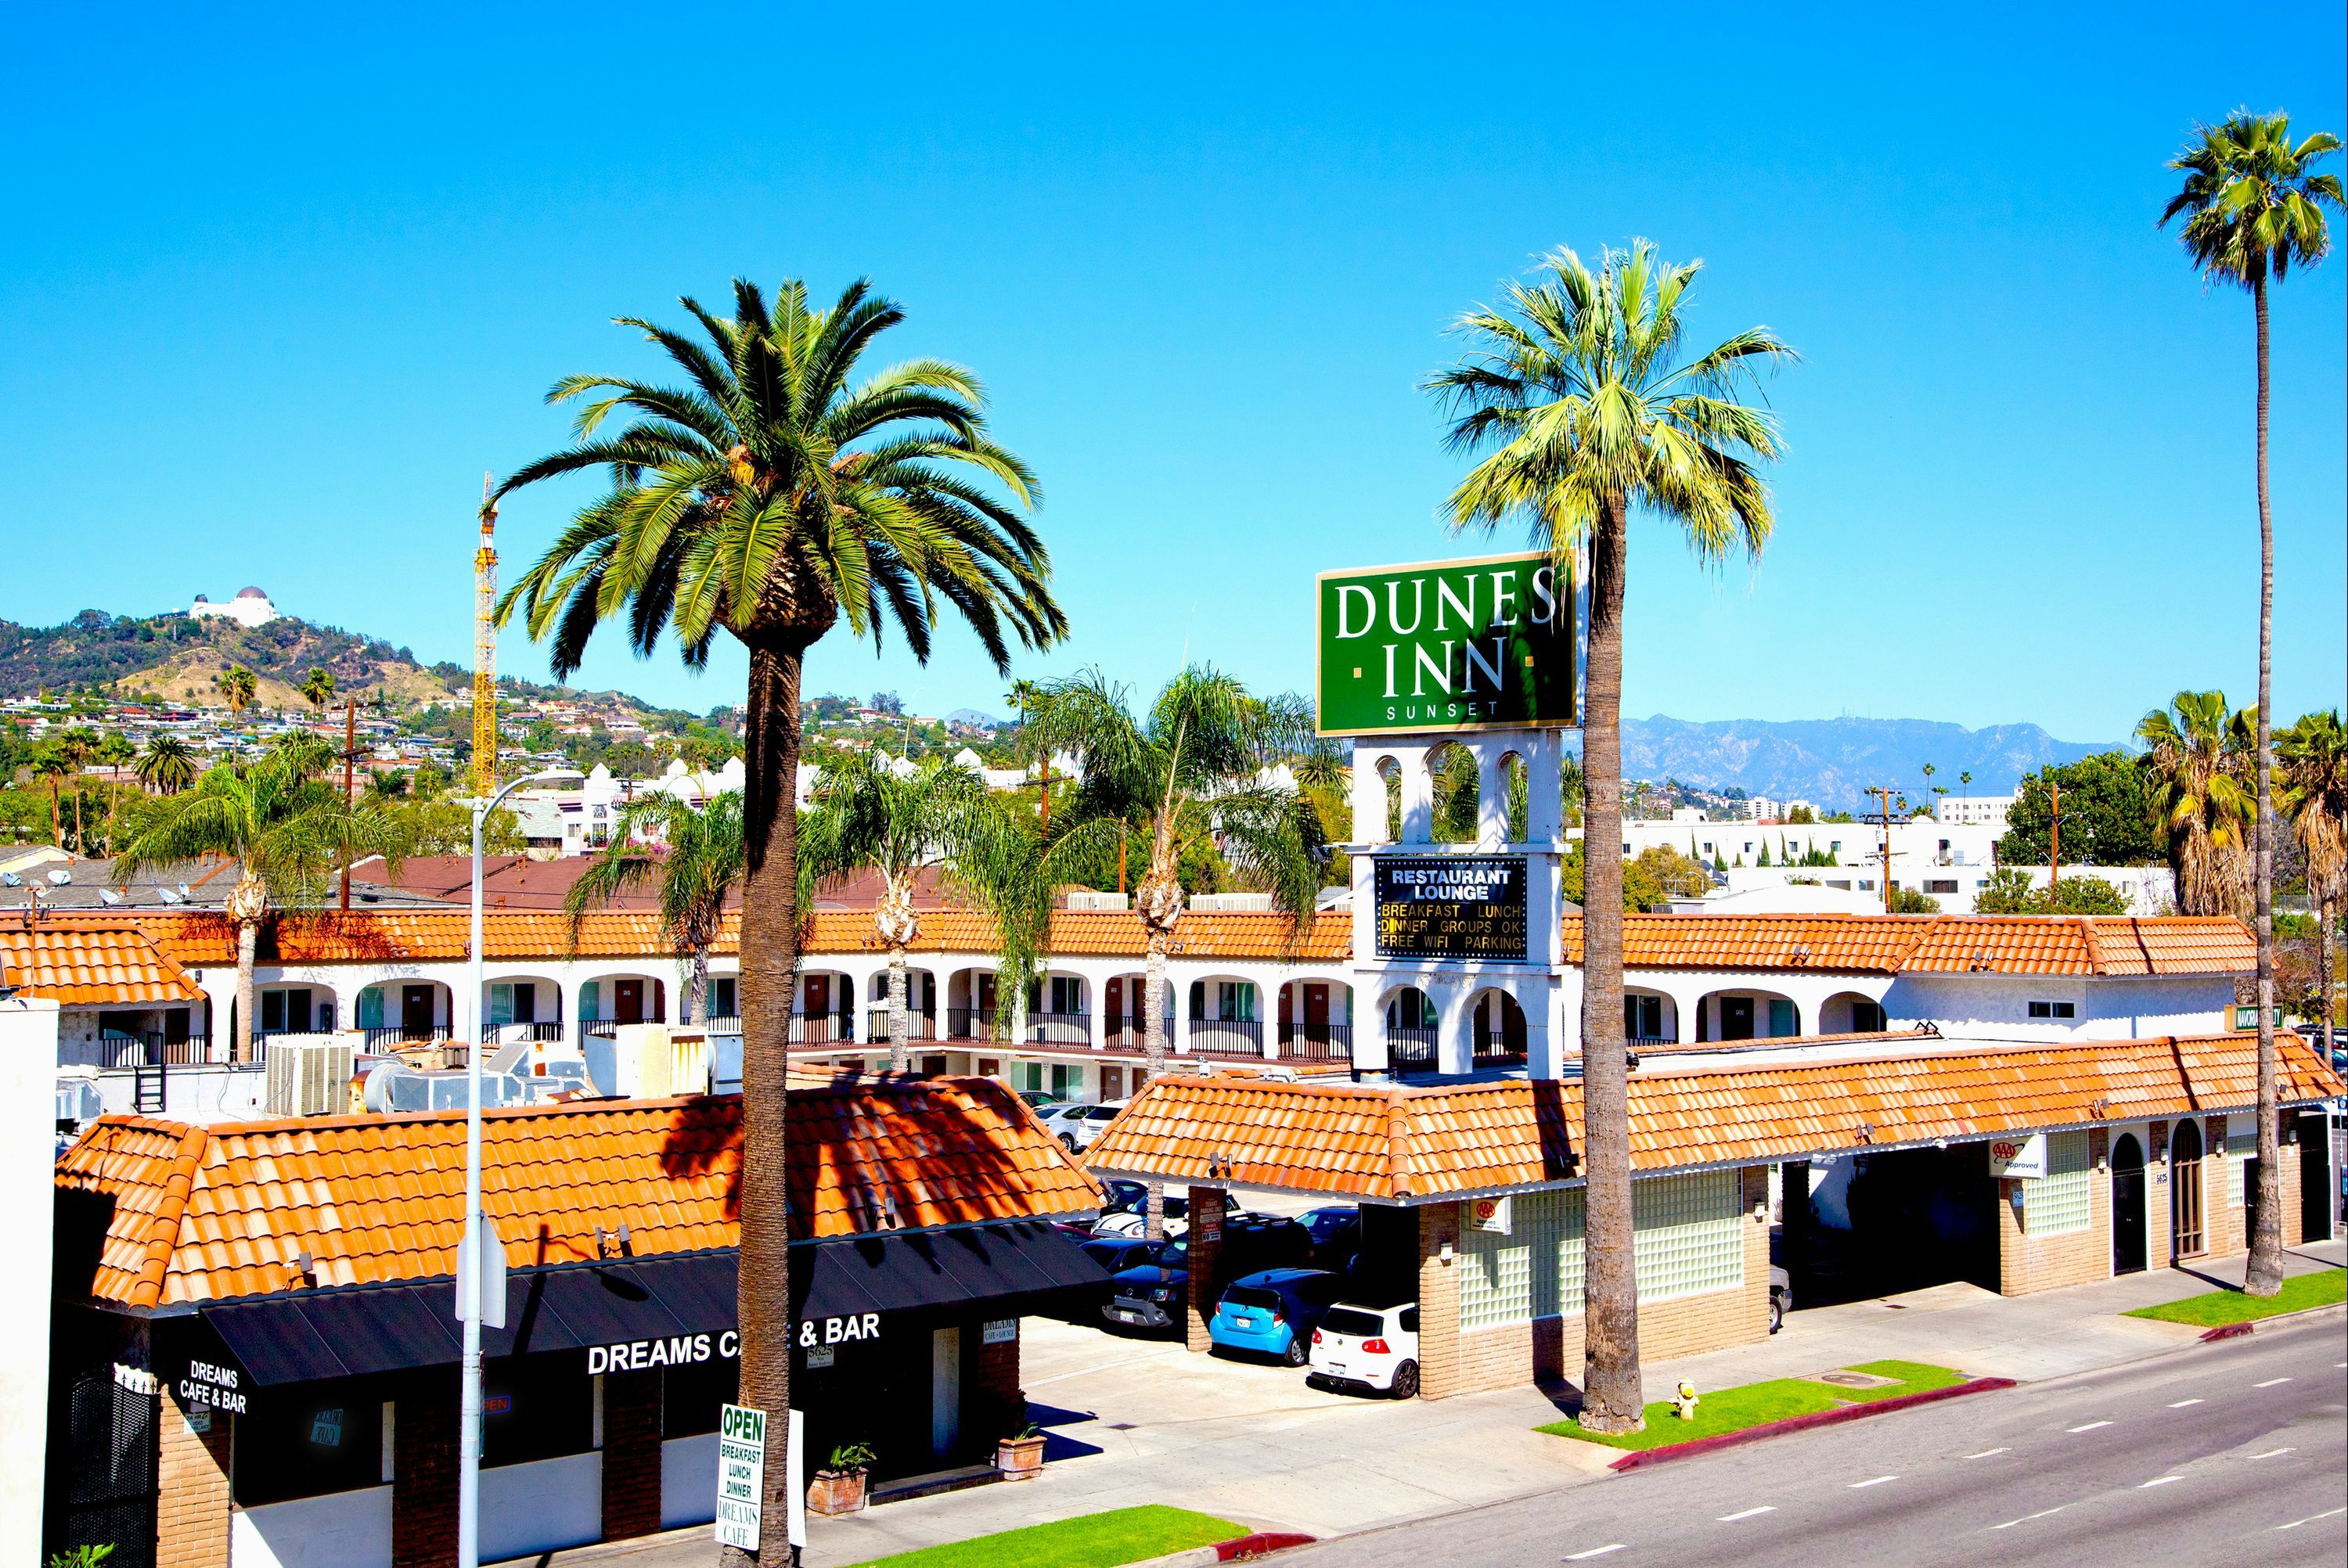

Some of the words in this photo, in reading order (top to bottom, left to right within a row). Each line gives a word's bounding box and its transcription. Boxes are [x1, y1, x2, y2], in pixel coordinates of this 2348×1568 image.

[1334, 566, 1556, 638] DUNES
[1382, 636, 1507, 698] INN
[1387, 701, 1497, 721] SUNSET
[1392, 869, 1511, 885] RESTAURANT
[1415, 885, 1489, 900] LOUNGE
[1381, 904, 1460, 917] BREAKFAST
[1478, 904, 1520, 918] LUNCH
[1440, 920, 1492, 933] GROUPS
[1501, 921, 1520, 933] OK
[1381, 934, 1415, 948] FREE
[1424, 935, 1448, 948] WIFI
[1465, 936, 1522, 949] PARKING
[1993, 1142, 2015, 1159] AAA
[2004, 1160, 2039, 1169] Approved
[1477, 1202, 1495, 1218] AAA
[985, 1331, 996, 1340] CAFE
[999, 1329, 1014, 1338] LOUNGE
[588, 1334, 710, 1375] DREAMS
[799, 1320, 818, 1347] &
[825, 1313, 880, 1344] BAR
[808, 1345, 833, 1358] 5625
[191, 1360, 238, 1389] DREAMS
[180, 1379, 210, 1404] CAFE
[212, 1388, 220, 1407] &
[222, 1391, 247, 1414] BAR
[723, 1407, 763, 1442] OPEN
[722, 1444, 762, 1464] BREAKFAST
[729, 1463, 751, 1480] LUNCH
[726, 1480, 751, 1498] DINNER
[718, 1500, 758, 1527] DREAMS
[723, 1523, 748, 1547] CAFE
